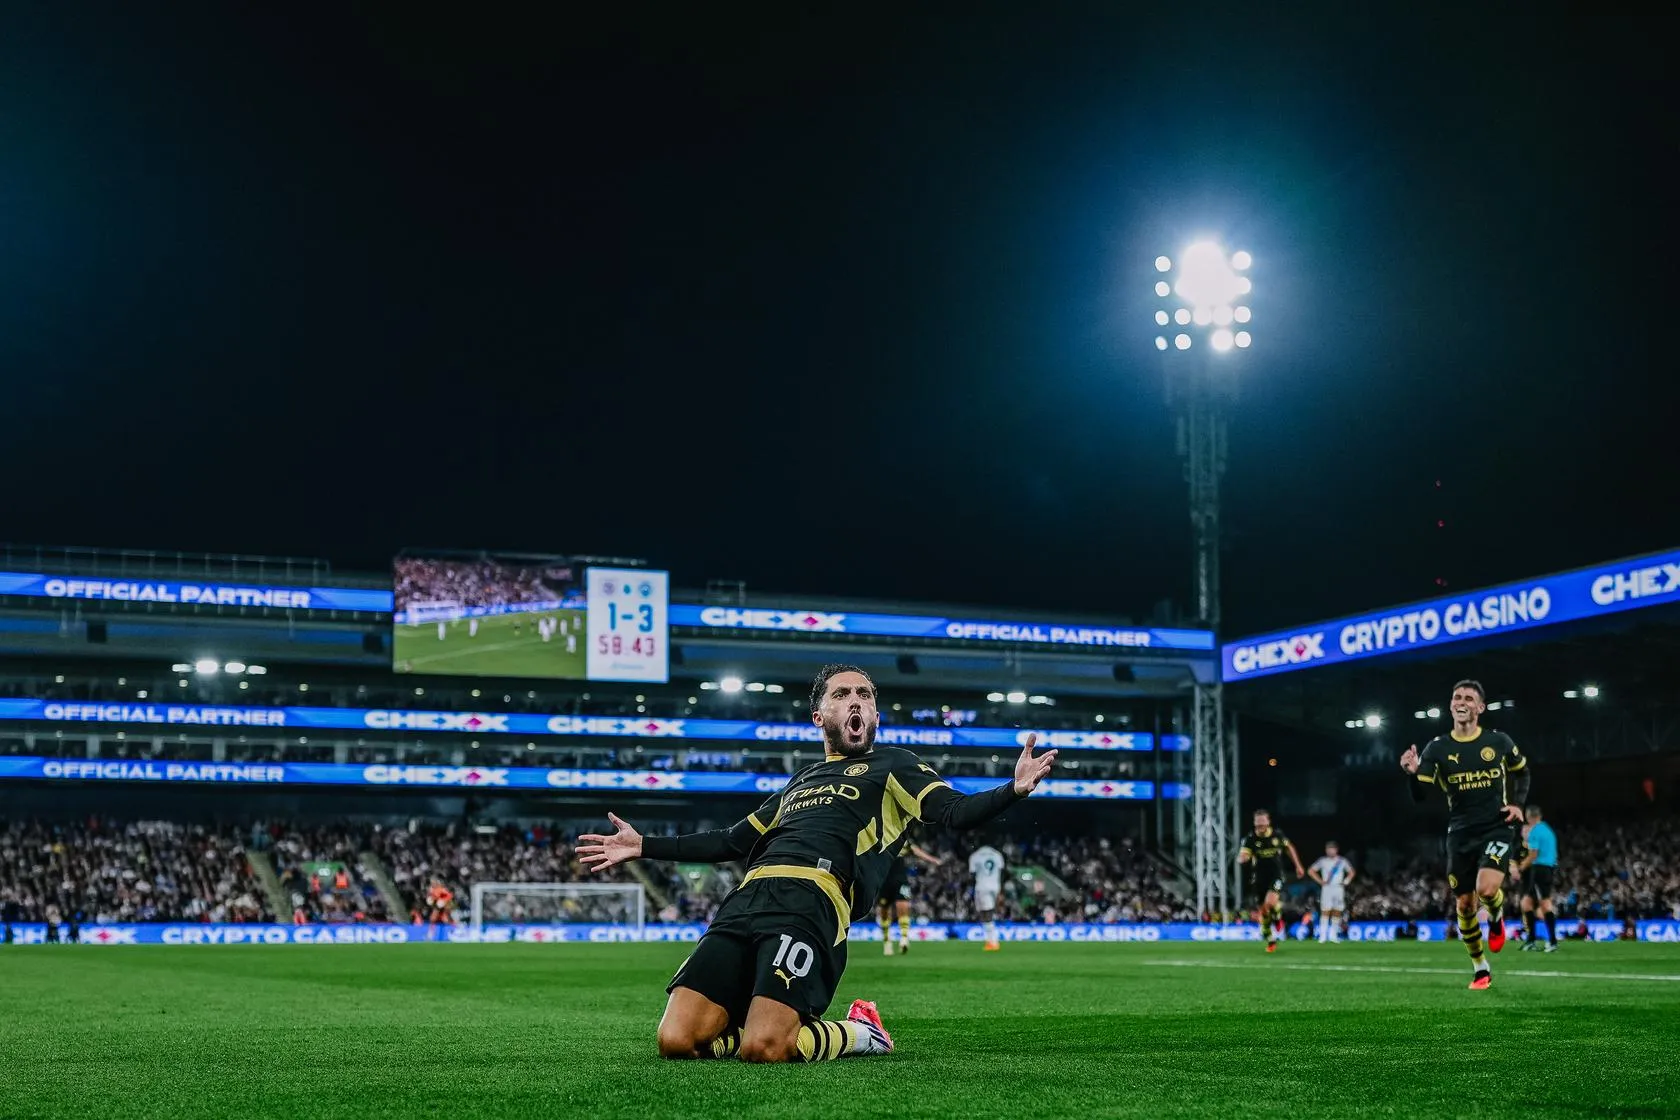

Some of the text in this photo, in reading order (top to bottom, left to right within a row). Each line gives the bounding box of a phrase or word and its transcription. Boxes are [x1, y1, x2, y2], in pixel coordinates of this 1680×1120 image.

[44, 579, 310, 608] OFFICIAL PARTNER
[1340, 609, 1440, 655] CRYPTO
[1444, 587, 1551, 635] CASINO
[946, 623, 1150, 647] OFFICIAL PARTNER
[44, 704, 285, 726] OFFICIAL PARTNER
[874, 728, 952, 746] ARTNER
[43, 761, 285, 782] OFFICIAL PARTNER
[1447, 768, 1501, 784] ETIHAD
[1459, 780, 1492, 791] AIRWAYS
[784, 796, 834, 814] AIRWAYS
[1484, 841, 1509, 858] 47
[161, 926, 288, 944] CRYPTO
[293, 926, 409, 944] CASINO
[966, 925, 1067, 943] CYPTO
[1069, 926, 1160, 942] CASINO
[772, 933, 815, 978] 10
